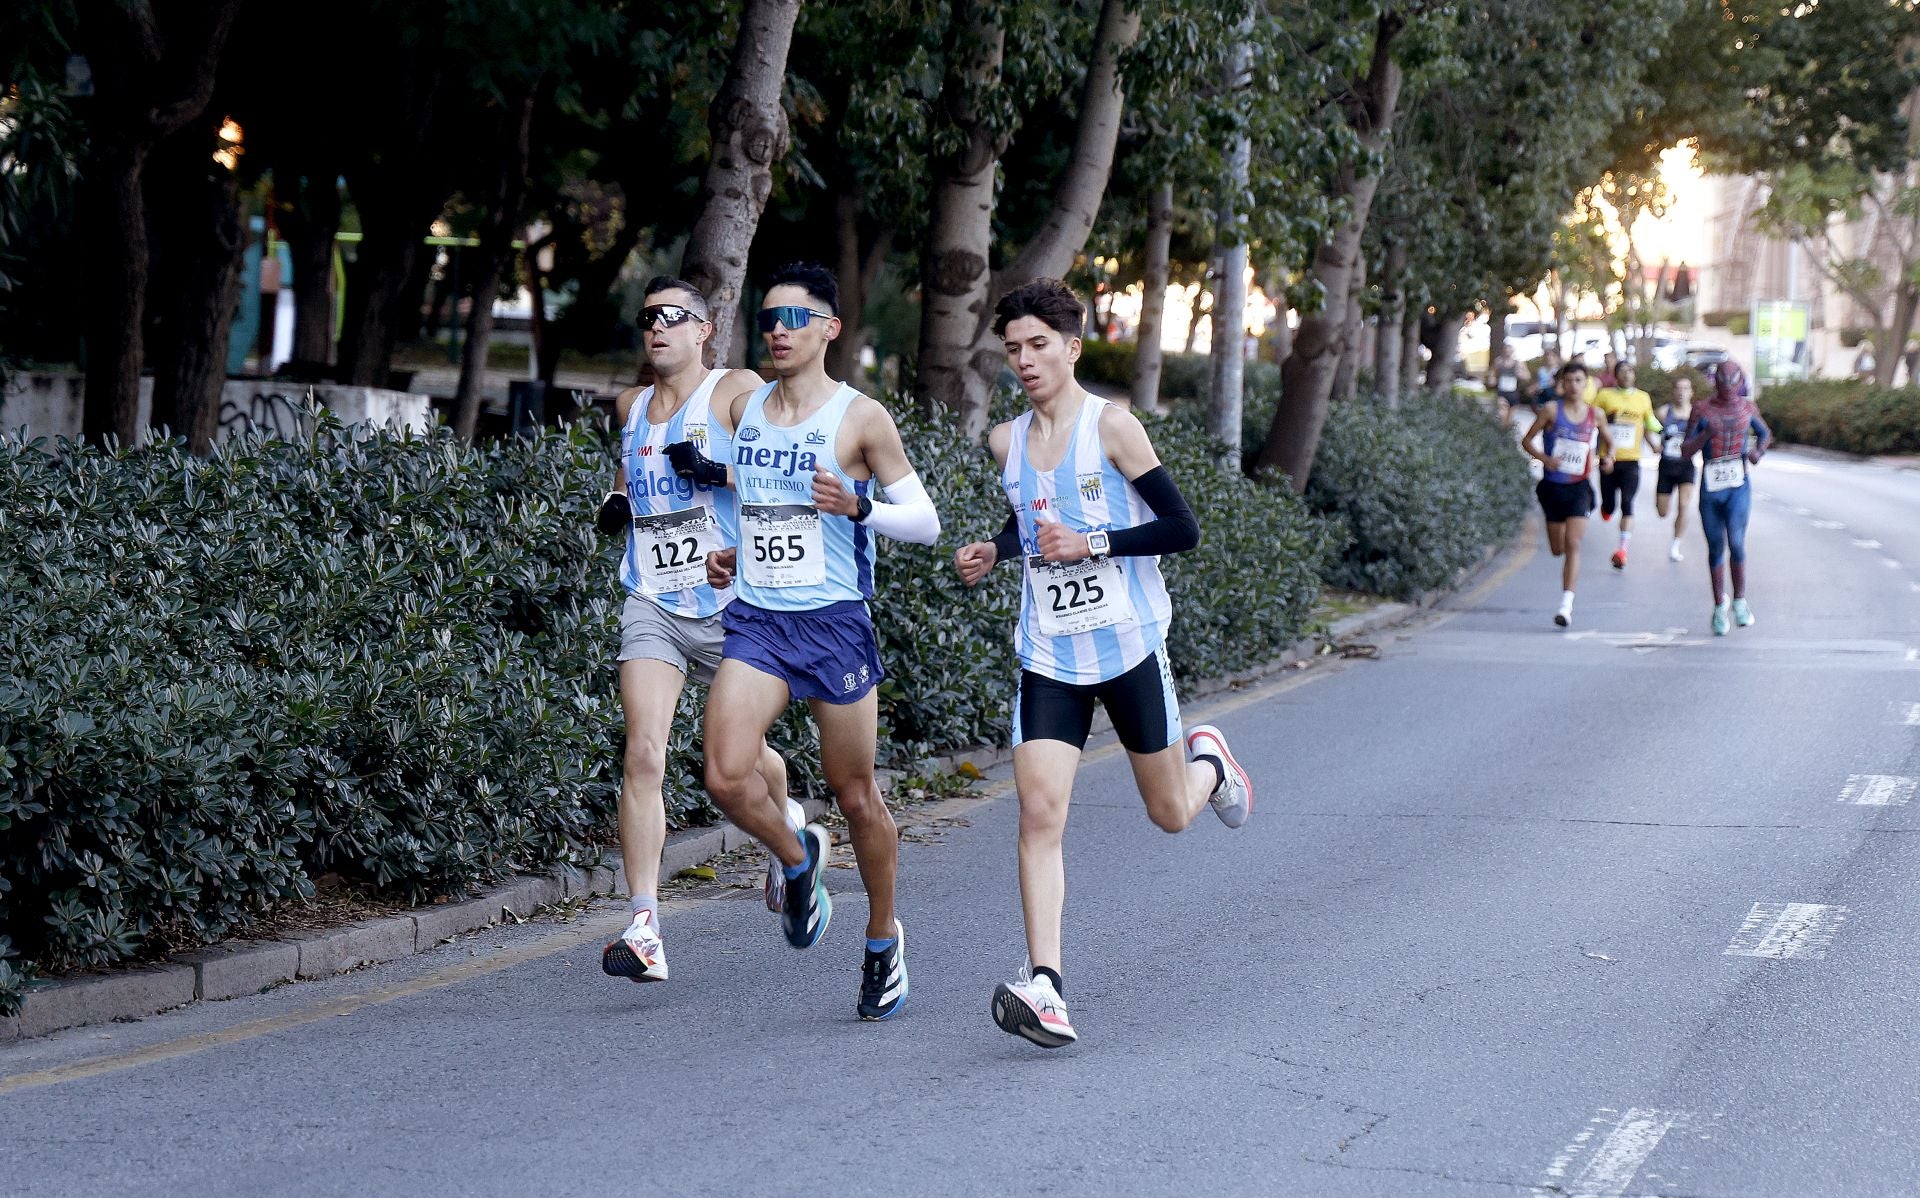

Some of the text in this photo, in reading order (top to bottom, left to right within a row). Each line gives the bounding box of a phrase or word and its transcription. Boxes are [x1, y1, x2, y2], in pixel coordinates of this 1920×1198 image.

[736, 443, 817, 477] nerja
[746, 476, 805, 492] ATLETISMO
[651, 537, 703, 569] 122
[753, 535, 805, 562] 565
[1046, 575, 1104, 611] 225
